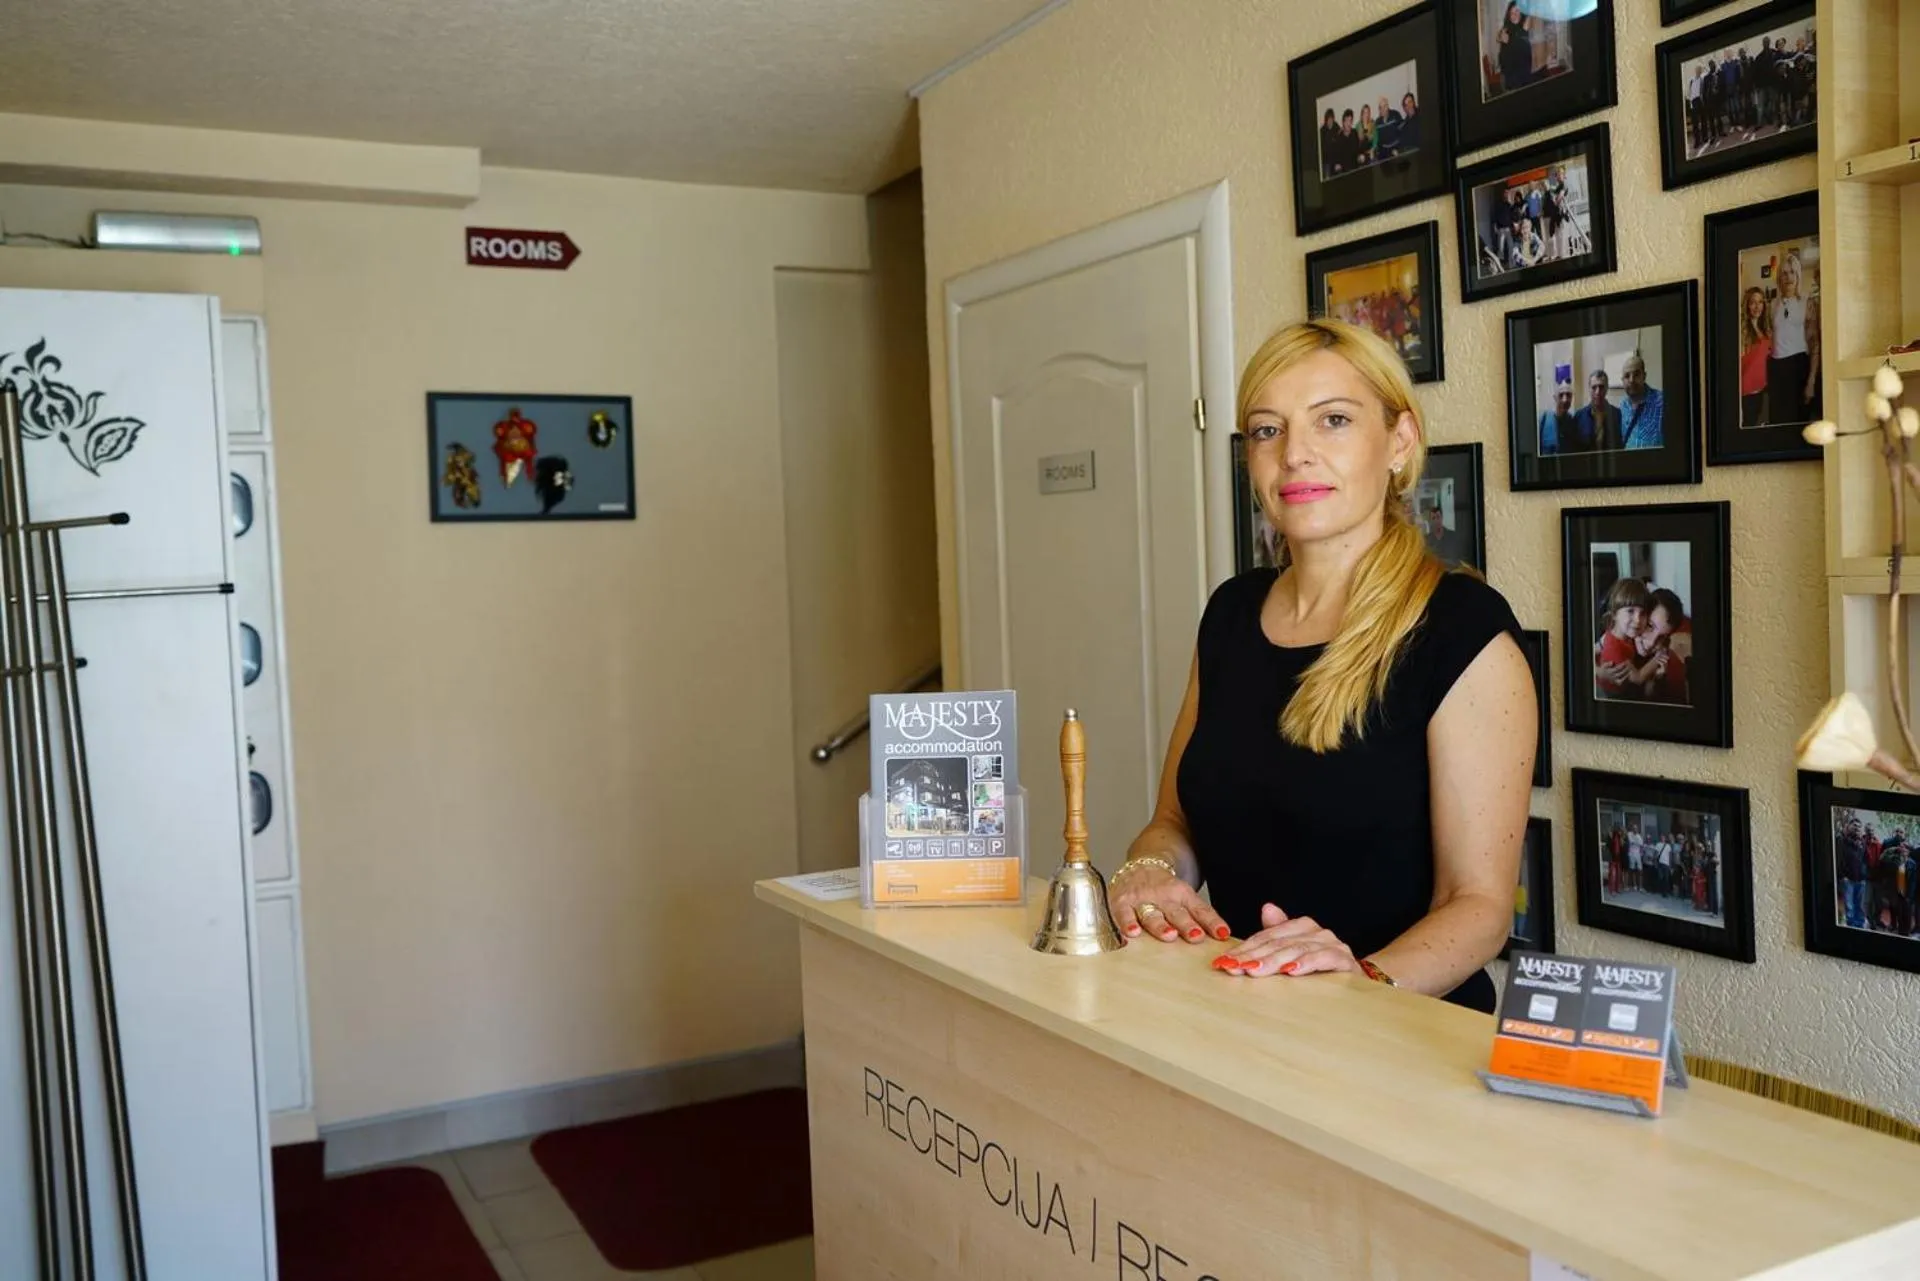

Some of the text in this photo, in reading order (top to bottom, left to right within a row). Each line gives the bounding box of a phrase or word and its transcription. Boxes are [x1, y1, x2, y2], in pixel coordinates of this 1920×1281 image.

[470, 236, 563, 261] ROOMS
[884, 699, 1003, 741] MAJESTY
[884, 739, 1003, 754] accommodation
[991, 840, 1002, 853] P
[1517, 956, 1585, 984] MAJESTY
[1594, 964, 1665, 993] MAJESTY
[863, 1066, 1076, 1256] RECEPCIJA
